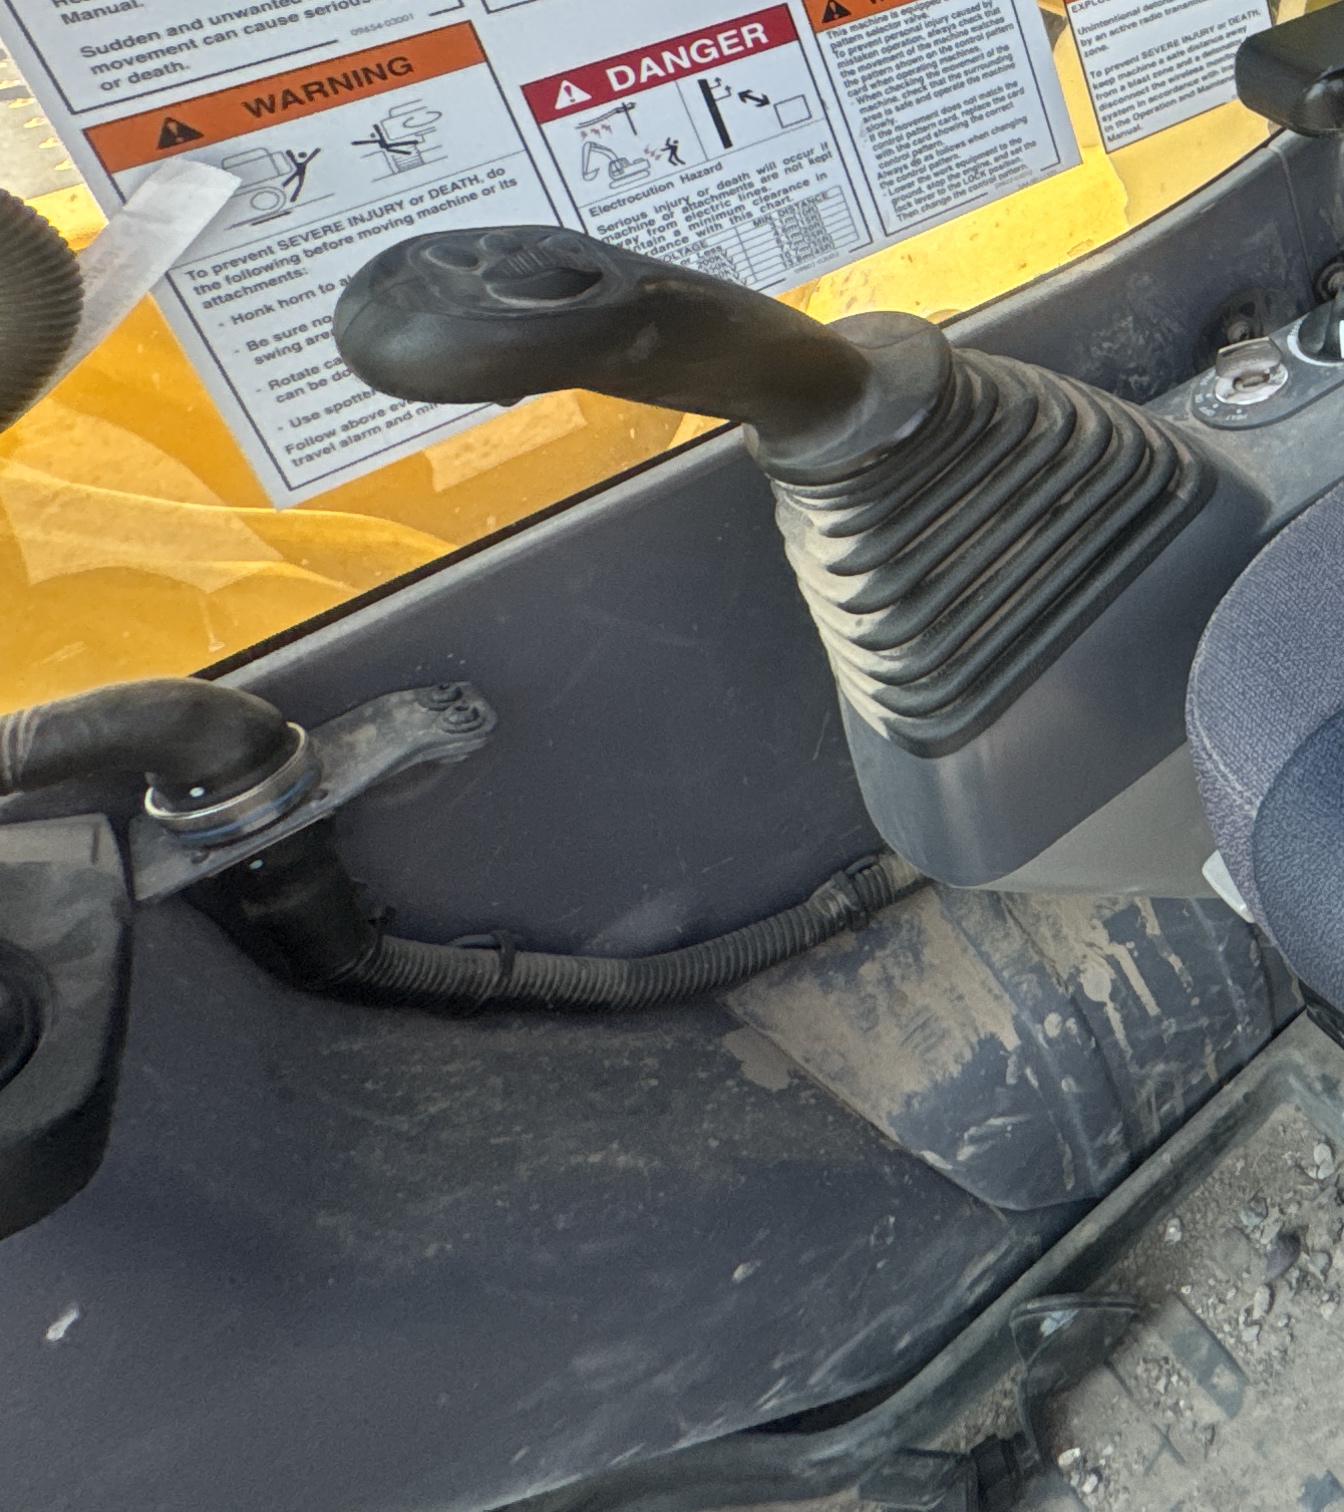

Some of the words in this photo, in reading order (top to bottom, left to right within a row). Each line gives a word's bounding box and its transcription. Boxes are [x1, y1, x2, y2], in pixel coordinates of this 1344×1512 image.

[80, 28, 161, 58] Sudden
[167, 19, 205, 38] and
[90, 38, 198, 76] movement
[203, 28, 238, 46] can
[243, 13, 300, 35] cause
[606, 22, 769, 92] DANGER
[100, 76, 121, 91] or
[128, 60, 191, 85] death.
[243, 55, 414, 118] WARNING
[589, 177, 675, 217] Electrocution
[679, 162, 723, 184] Hazard
[596, 211, 648, 235] Serious
[654, 195, 691, 216] injury
[697, 188, 710, 198] or
[716, 172, 750, 191] death
[756, 161, 776, 176] will
[783, 150, 815, 169] occur
[185, 269, 209, 282] To
[212, 245, 275, 277] prevent
[277, 221, 346, 251] SEVERE
[349, 200, 405, 227] INJURY
[409, 195, 425, 207] or
[428, 175, 486, 201] DEATH,
[487, 166, 506, 182] do
[231, 303, 275, 326] Honk
[278, 289, 316, 308] horn
[319, 282, 336, 294] to
